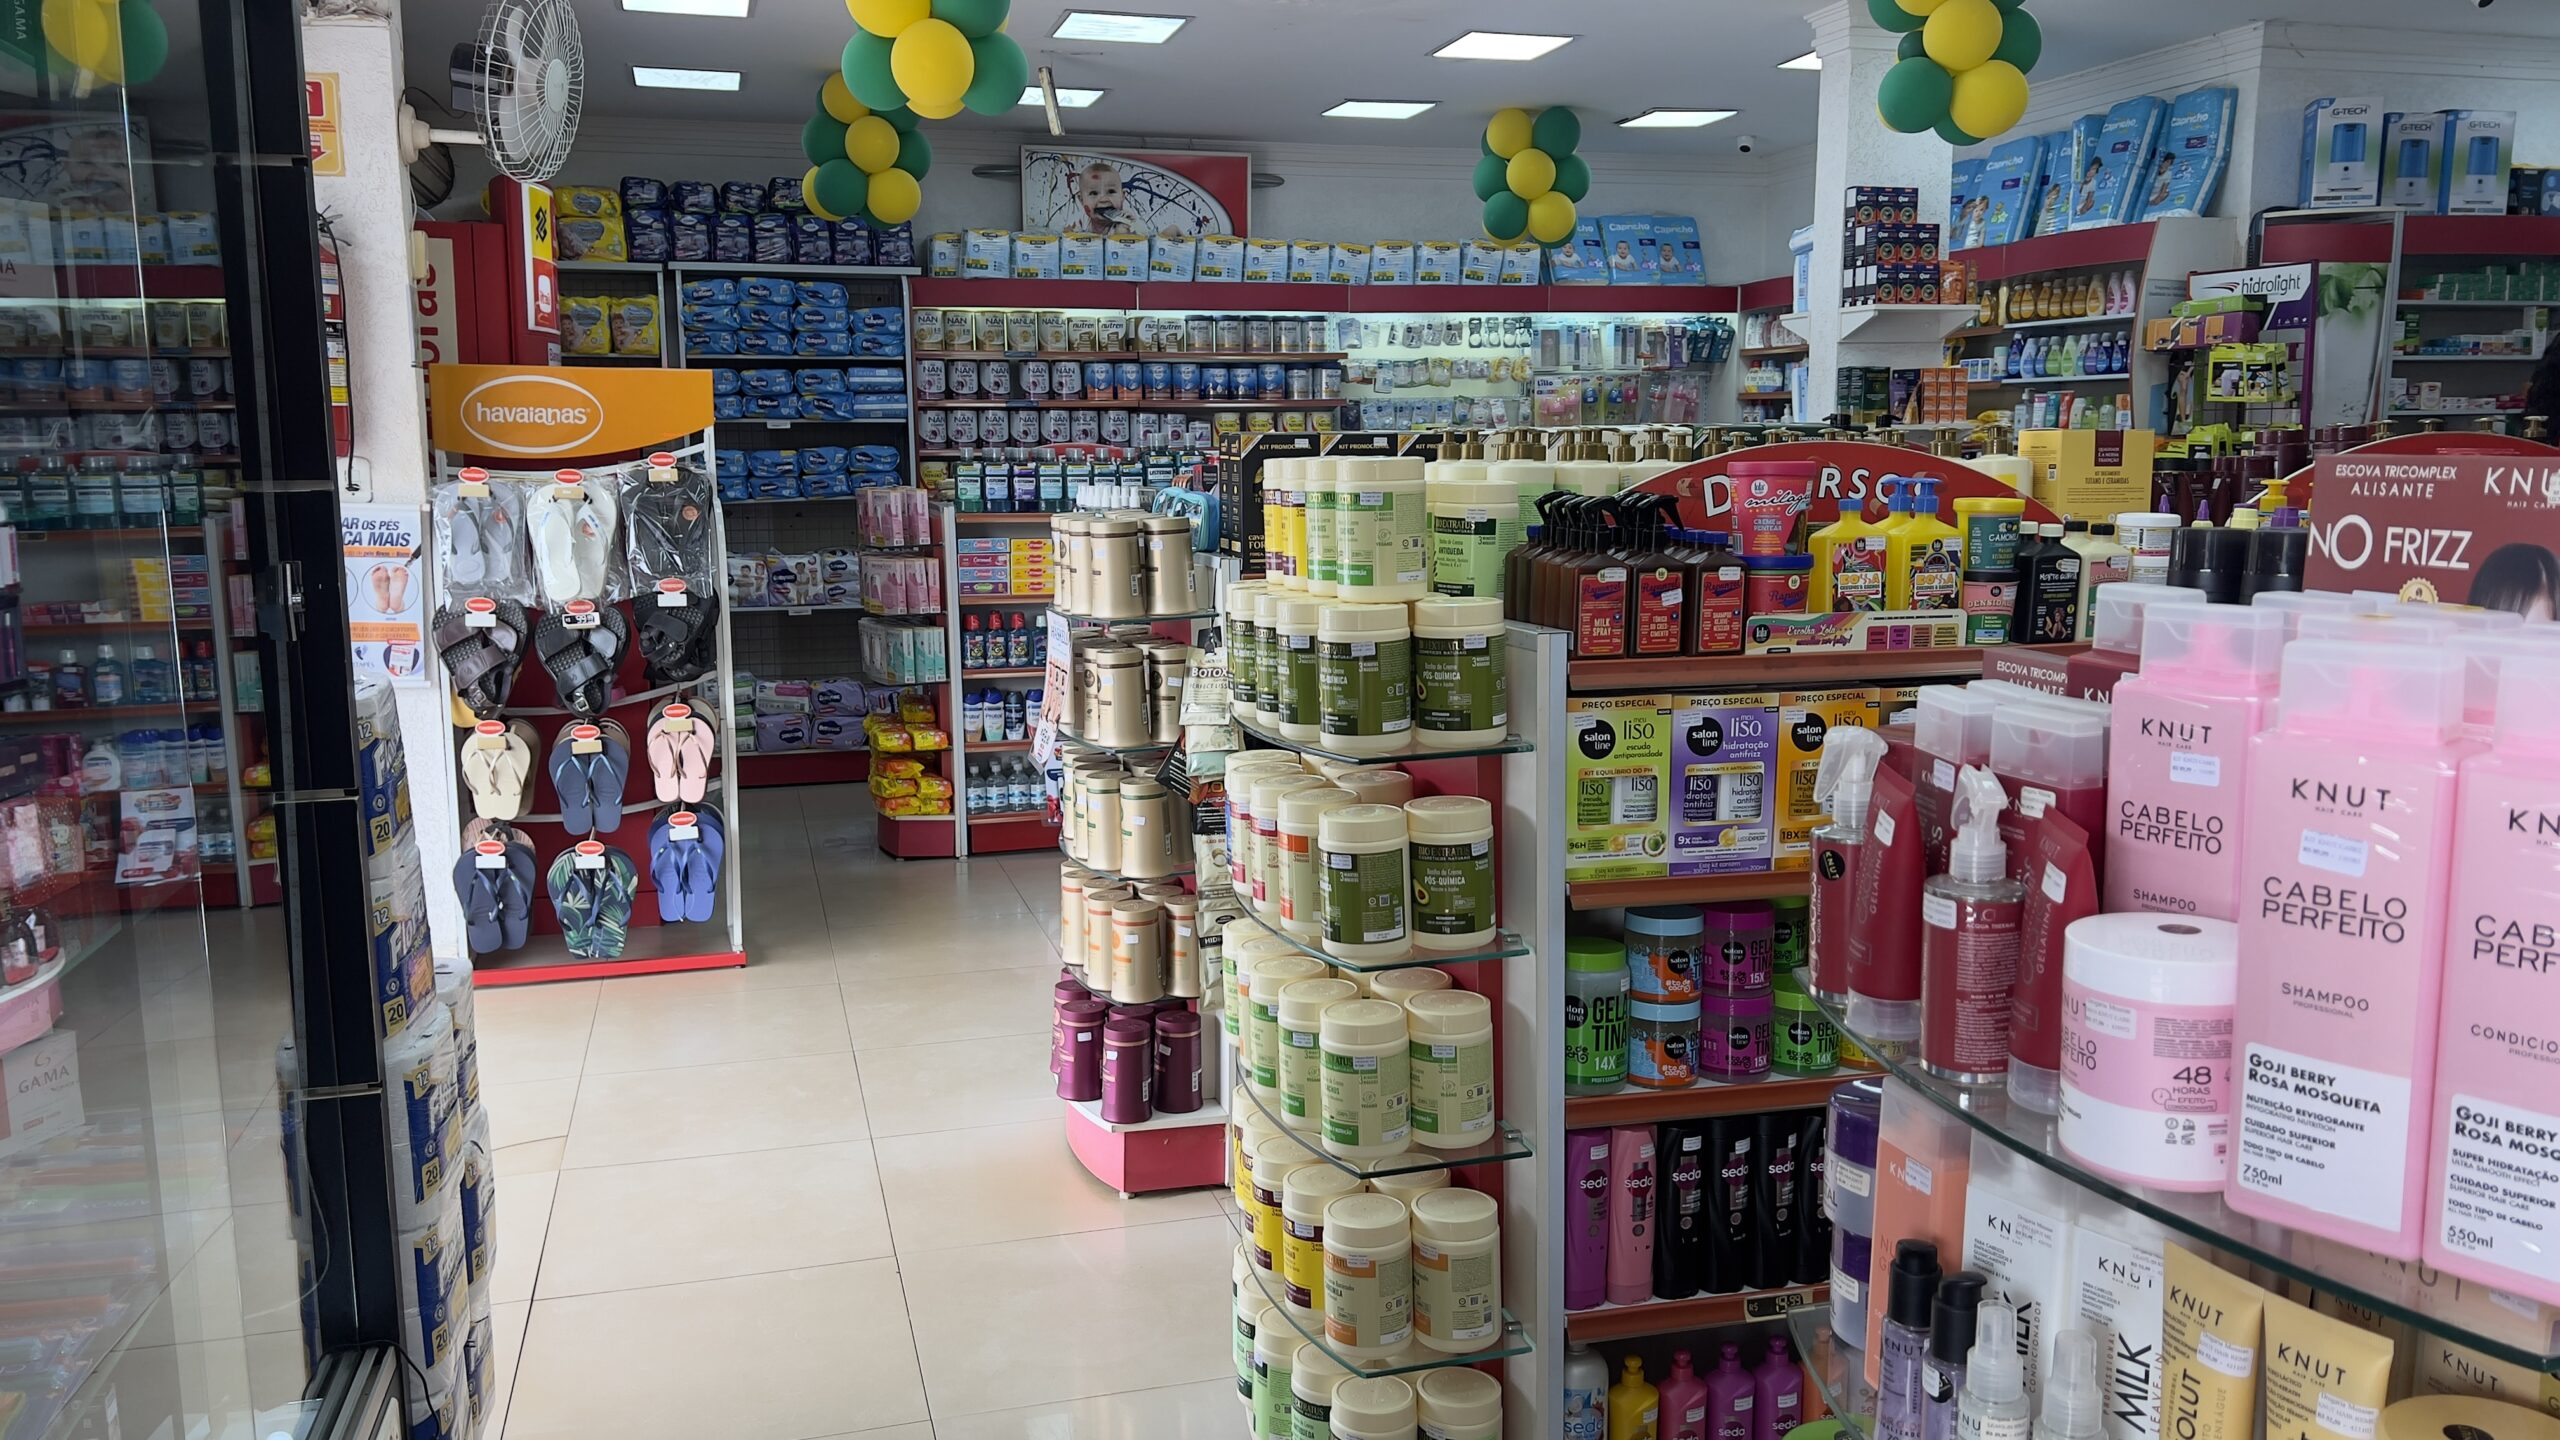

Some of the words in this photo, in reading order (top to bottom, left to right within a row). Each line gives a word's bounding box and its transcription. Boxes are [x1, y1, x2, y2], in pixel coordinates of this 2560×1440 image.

[2332, 105, 2368, 116] G-TECH
[2102, 117, 2139, 134] Capricho
[2171, 112, 2209, 128] Capricho
[2400, 123, 2432, 132] G-TECH
[2469, 120, 2501, 129] G-TECH
[1986, 154, 2024, 171] Capricho
[1609, 222, 1650, 231] Capricho
[2241, 274, 2301, 296] hidrolight
[918, 315, 938, 324] NAN
[947, 317, 967, 325] NAN
[986, 317, 1004, 325] NAN
[476, 403, 587, 426] havaianas
[2335, 464, 2381, 478] ESCOVA
[2384, 465, 2458, 480] TRICOMPLEX
[2106, 477, 2129, 485] CERAMIDAS
[2351, 482, 2435, 499] ALISANTE
[362, 520, 376, 531] OS
[379, 519, 400, 531] PÉS
[367, 532, 411, 548] MAIS
[2308, 514, 2373, 570] NO
[2384, 526, 2473, 570] FRIZZ
[1594, 618, 1610, 627] MILK
[1593, 626, 1611, 636] SPRAY
[1191, 667, 1228, 678] BOTOX
[1423, 669, 1461, 681] PÓS-QUÍMICA
[1996, 660, 2028, 676] ESCOVA
[1582, 701, 1613, 710] PREÇO
[1615, 700, 1656, 708] ESPECIAL
[1690, 699, 1721, 708] PREÇO
[1723, 697, 1765, 706] ESPECIAL
[1795, 694, 1824, 703] PREÇO
[1826, 692, 1866, 701] ESPECIAL
[357, 722, 373, 740] 12
[1623, 720, 1655, 740] liso
[1692, 730, 1718, 739] salon
[1730, 718, 1762, 738] liso
[1797, 726, 1822, 735] salon
[2141, 718, 2212, 744] KNUT
[1584, 733, 1611, 742] salon
[1702, 738, 1718, 747] line
[1806, 734, 1822, 743] line
[1594, 742, 1611, 750] line
[1626, 742, 1651, 751] escudo
[1723, 741, 1769, 751] hidratação
[1614, 750, 1664, 760] antiporosidade
[1729, 751, 1761, 759] antifrizz
[1596, 768, 1631, 776] EQUILÍBRIO
[1581, 780, 1604, 796] liso
[1631, 776, 1653, 792] liso
[1690, 776, 1712, 791] liso
[2291, 778, 2391, 811] KNUT
[2121, 800, 2223, 835] CABELO
[2340, 809, 2363, 818] CARE
[375, 821, 391, 839] 20
[1782, 832, 1800, 840] 18X
[2120, 819, 2222, 855] PERFEITO
[1569, 841, 1587, 849] 96H
[1678, 836, 1691, 844] 9x
[1824, 851, 1840, 880] KNUT
[1424, 875, 1466, 885] PÓS-QUÍMICA
[1870, 850, 1882, 914] GELATINA
[2133, 888, 2196, 912] SHAMPOO
[2263, 876, 2407, 920] CABELO
[373, 907, 389, 925] 12
[2262, 898, 2405, 943] PERFEITO
[2037, 901, 2053, 975] GELATINA
[1750, 973, 1764, 983] 15X
[2281, 982, 2370, 1012] SHAMPOO
[388, 1003, 404, 1022] 20
[2293, 1000, 2355, 1018] PROFESSIONAL
[1592, 1022, 1628, 1052] TINA
[1595, 1056, 1616, 1071] 14X
[1754, 1057, 1767, 1067] 15X
[1817, 1053, 1831, 1064] 14X
[2172, 1066, 2213, 1086] 48
[2249, 1053, 2286, 1075] GOJI
[2290, 1066, 2337, 1087] BERRY
[18, 1065, 70, 1094] GAMA
[416, 1069, 429, 1088] 12
[2172, 1087, 2211, 1095] HORAS
[2248, 1067, 2289, 1092] ROSA
[2294, 1083, 2382, 1114] MOSQUETA
[2177, 1097, 2207, 1105] EFEITO
[2246, 1093, 2293, 1113] NUTRIÇÃO
[2295, 1107, 2365, 1132] REVIGORANTE
[2456, 1105, 2499, 1130] GOJI
[2505, 1119, 2559, 1144] BERRY
[2245, 1117, 2286, 1135] CUIDADO
[2289, 1130, 2336, 1149] SUPERIOR
[2455, 1121, 2503, 1147] ROSA
[2295, 1140, 2313, 1152] CARE
[2243, 1140, 2264, 1152] TODO
[2265, 1146, 2282, 1158] TIPO
[2284, 1152, 2294, 1161] DE
[2295, 1155, 2326, 1170] CABELO
[1722, 1165, 1748, 1178] seda
[1769, 1161, 1795, 1174] seda
[2452, 1157, 2474, 1170] ULTRA
[2452, 1148, 2485, 1164] SUPER
[2487, 1156, 2559, 1185] HIDRATAÇÃO
[424, 1167, 439, 1183] 20
[1625, 1176, 1653, 1188] seda
[1672, 1169, 1701, 1182] seda
[2243, 1163, 2283, 1186] 750ml
[1580, 1178, 1608, 1190] seda
[2450, 1173, 2499, 1194] CUIDADO
[2502, 1186, 2556, 1210] SUPERIOR
[2450, 1184, 2486, 1200] SUPERIOR
[2487, 1192, 2508, 1206] HAIR
[2508, 1197, 2531, 1212] CARE
[2448, 1198, 2473, 1211] TODO
[2474, 1205, 2494, 1218] TIPO
[2496, 1211, 2507, 1221] DE
[2509, 1215, 2544, 1232] CABELO
[425, 1237, 438, 1253] 12
[2447, 1225, 2494, 1249] 550ml
[474, 1253, 485, 1267] 20
[2169, 1285, 2224, 1327] KNUT
[435, 1328, 449, 1345] 20
[2278, 1343, 2346, 1386] KNUT
[2443, 1350, 2498, 1392] KNUT
[2114, 1332, 2152, 1434] MILK
[1718, 1426, 1746, 1437] seda
[1772, 1418, 1797, 1431] seda
